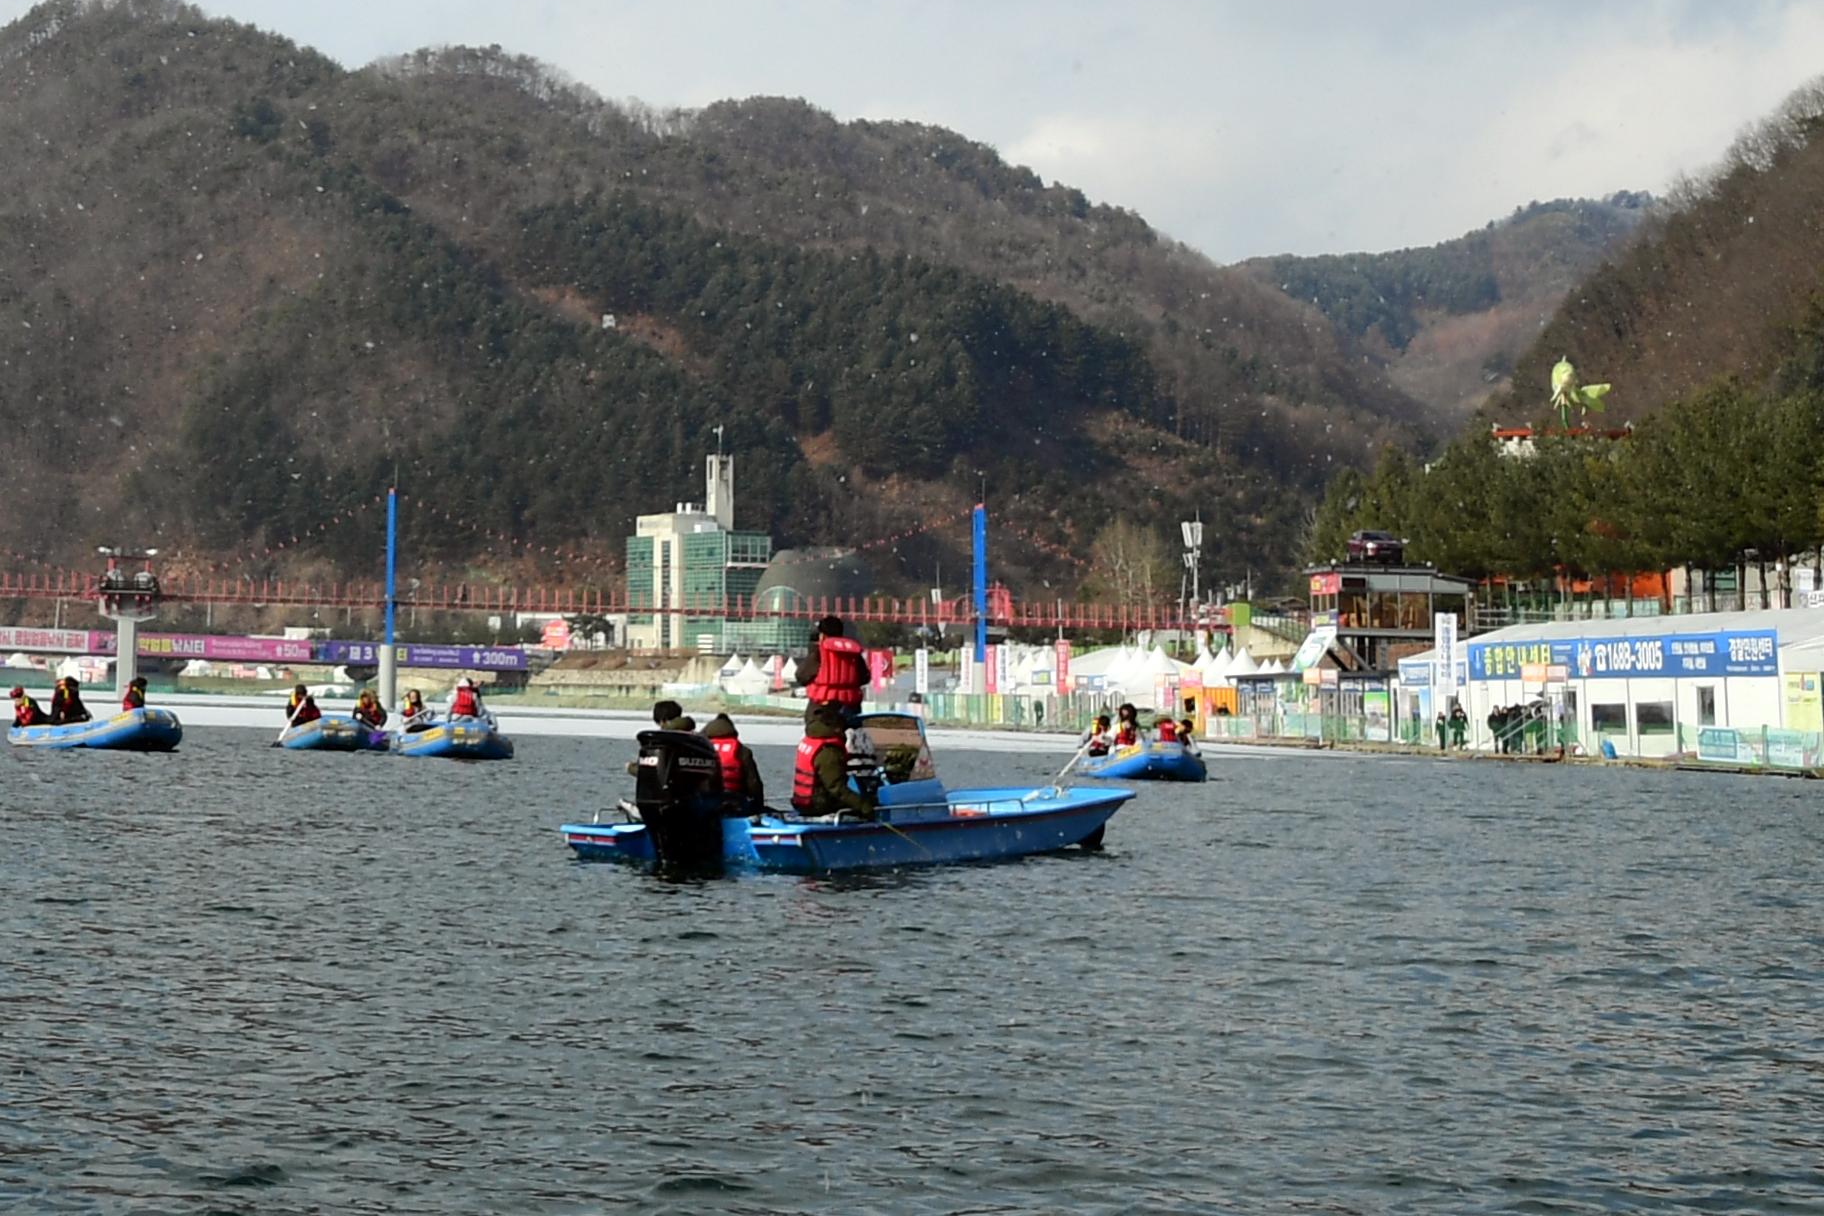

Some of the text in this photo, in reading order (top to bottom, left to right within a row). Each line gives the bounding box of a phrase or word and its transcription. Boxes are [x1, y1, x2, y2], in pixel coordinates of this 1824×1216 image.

[284, 644, 309, 659] 50m
[364, 647, 373, 660] 3
[483, 652, 518, 666] 300m
[1607, 640, 1663, 671] 1688-3005
[1484, 643, 1550, 676] 종합안내센터
